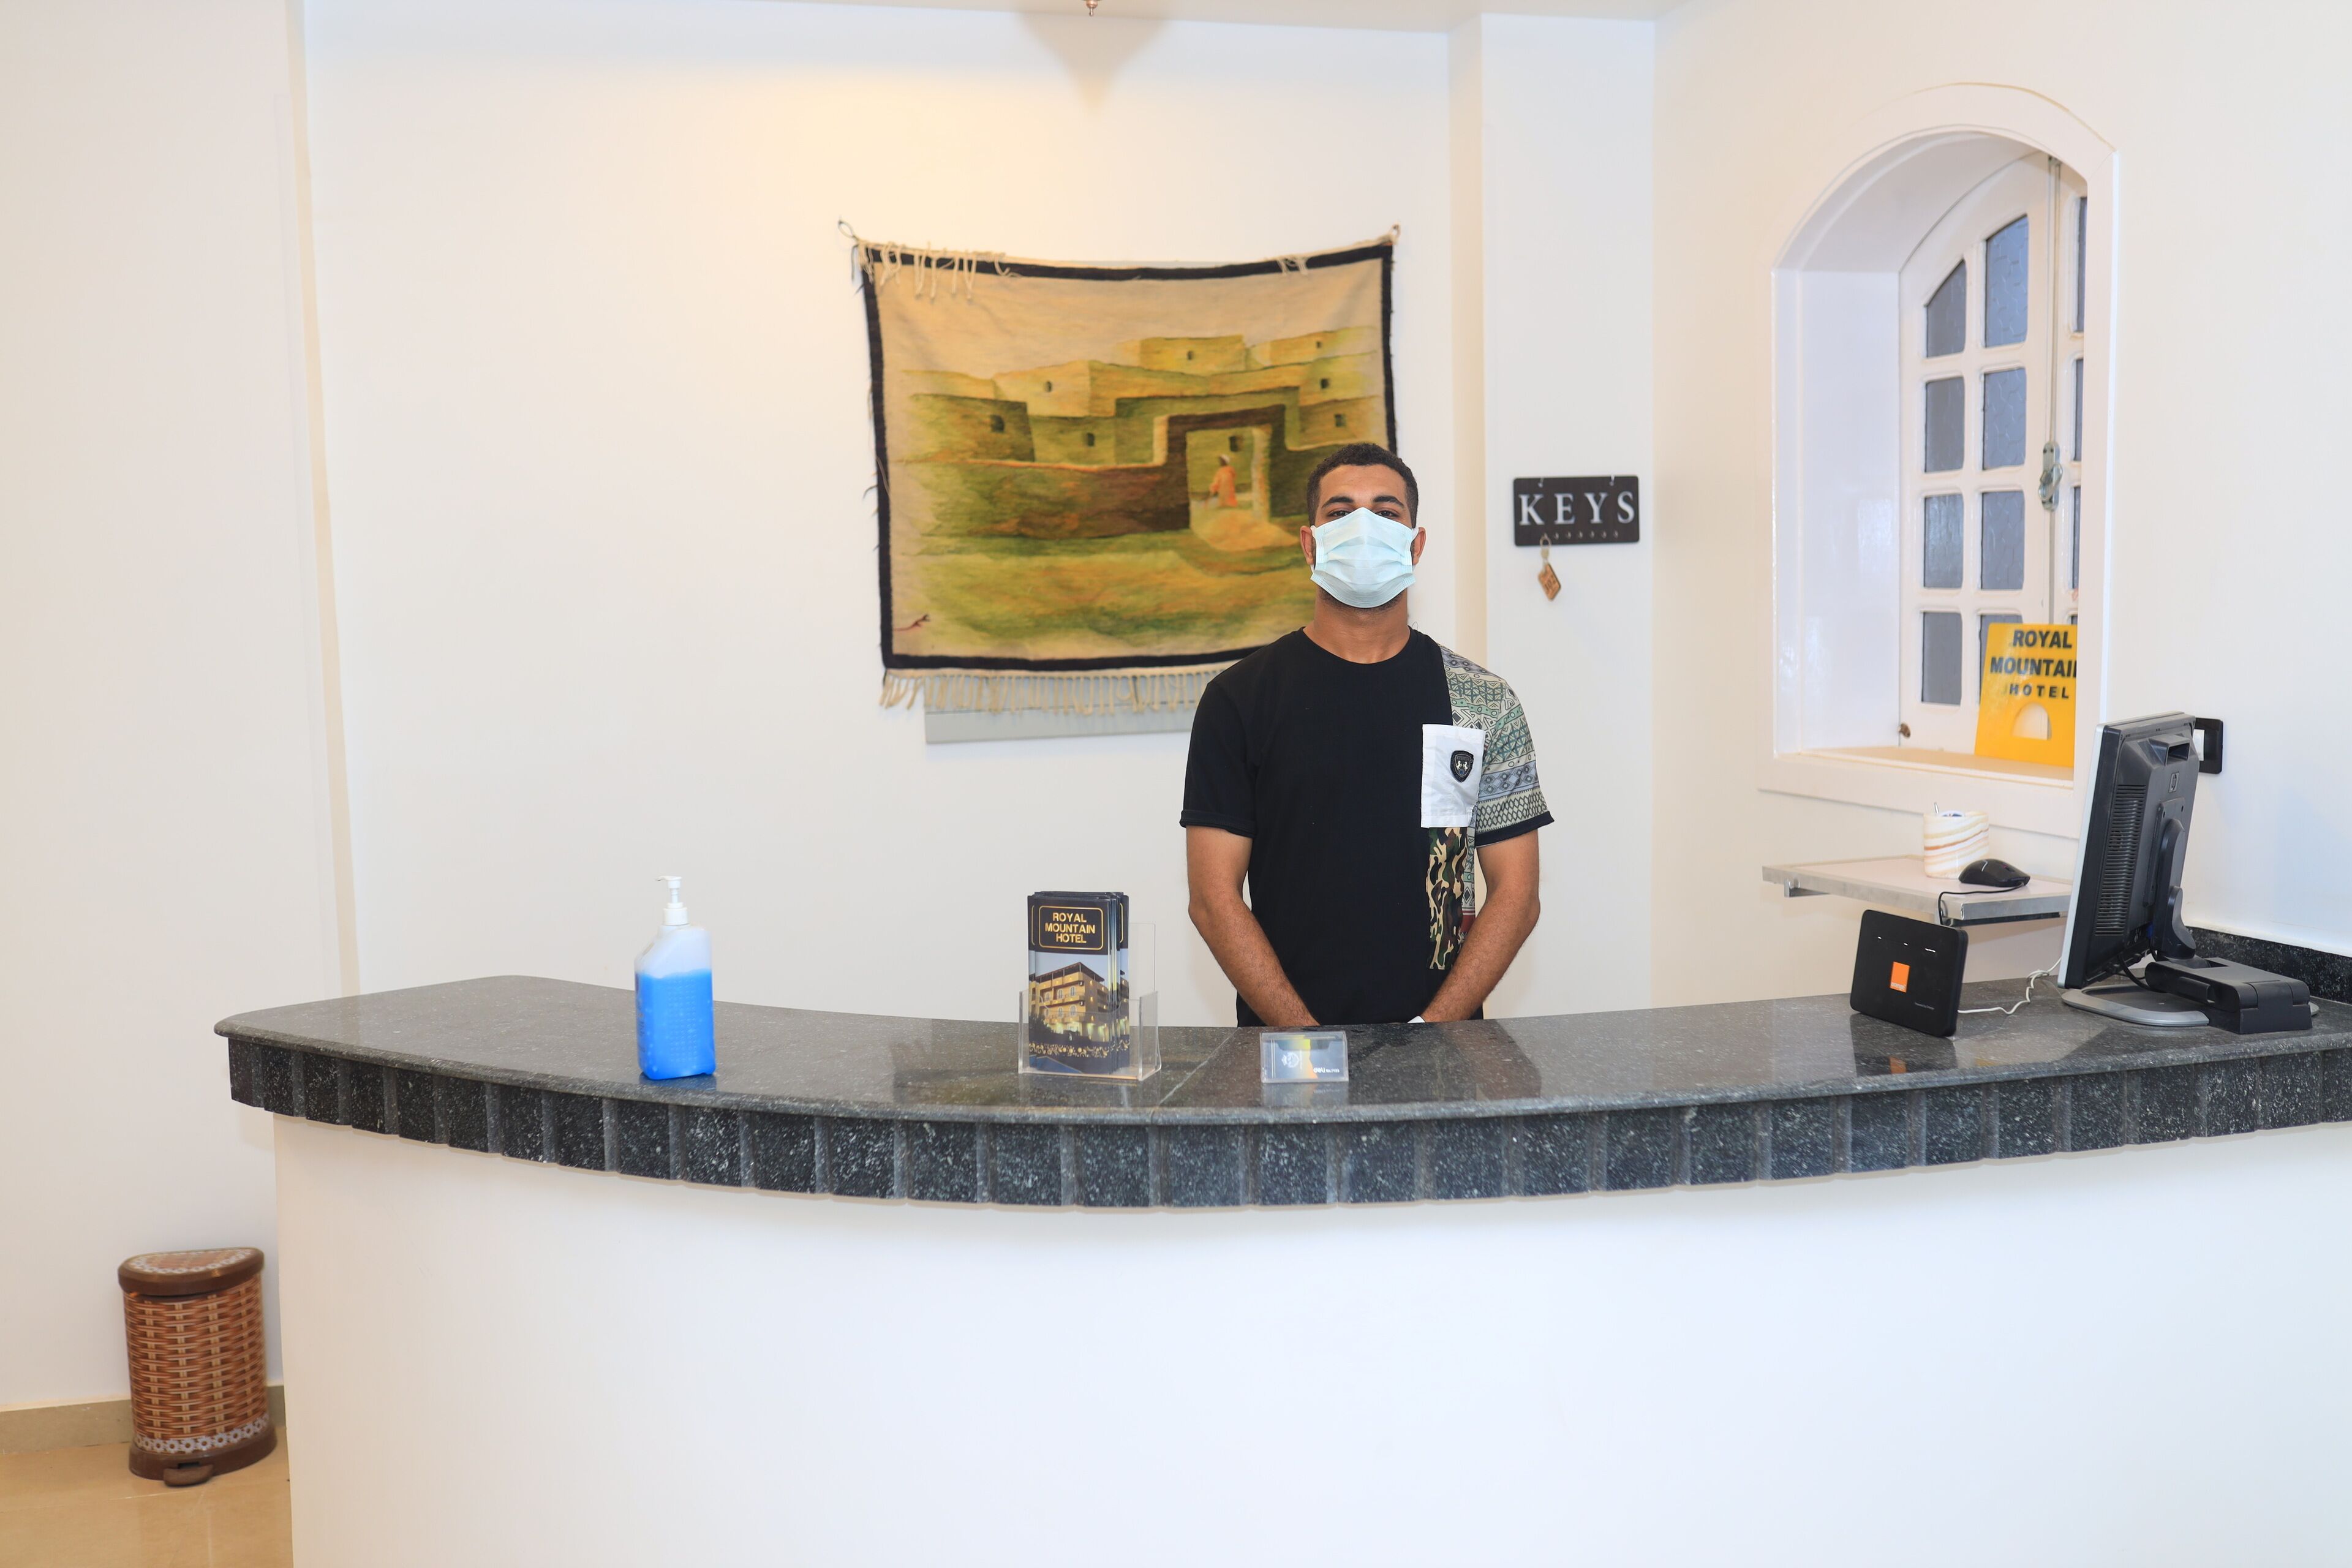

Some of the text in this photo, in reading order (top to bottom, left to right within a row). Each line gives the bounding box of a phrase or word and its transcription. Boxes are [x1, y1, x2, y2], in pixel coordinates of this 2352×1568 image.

[1518, 491, 1635, 526] KEYS
[2013, 630, 2072, 649] ROYAL
[2009, 684, 2069, 699] HOTEL
[1052, 912, 1087, 922] ROYAL
[1045, 922, 1095, 934] MOUNTAIN
[1056, 933, 1087, 943] HOTEL
